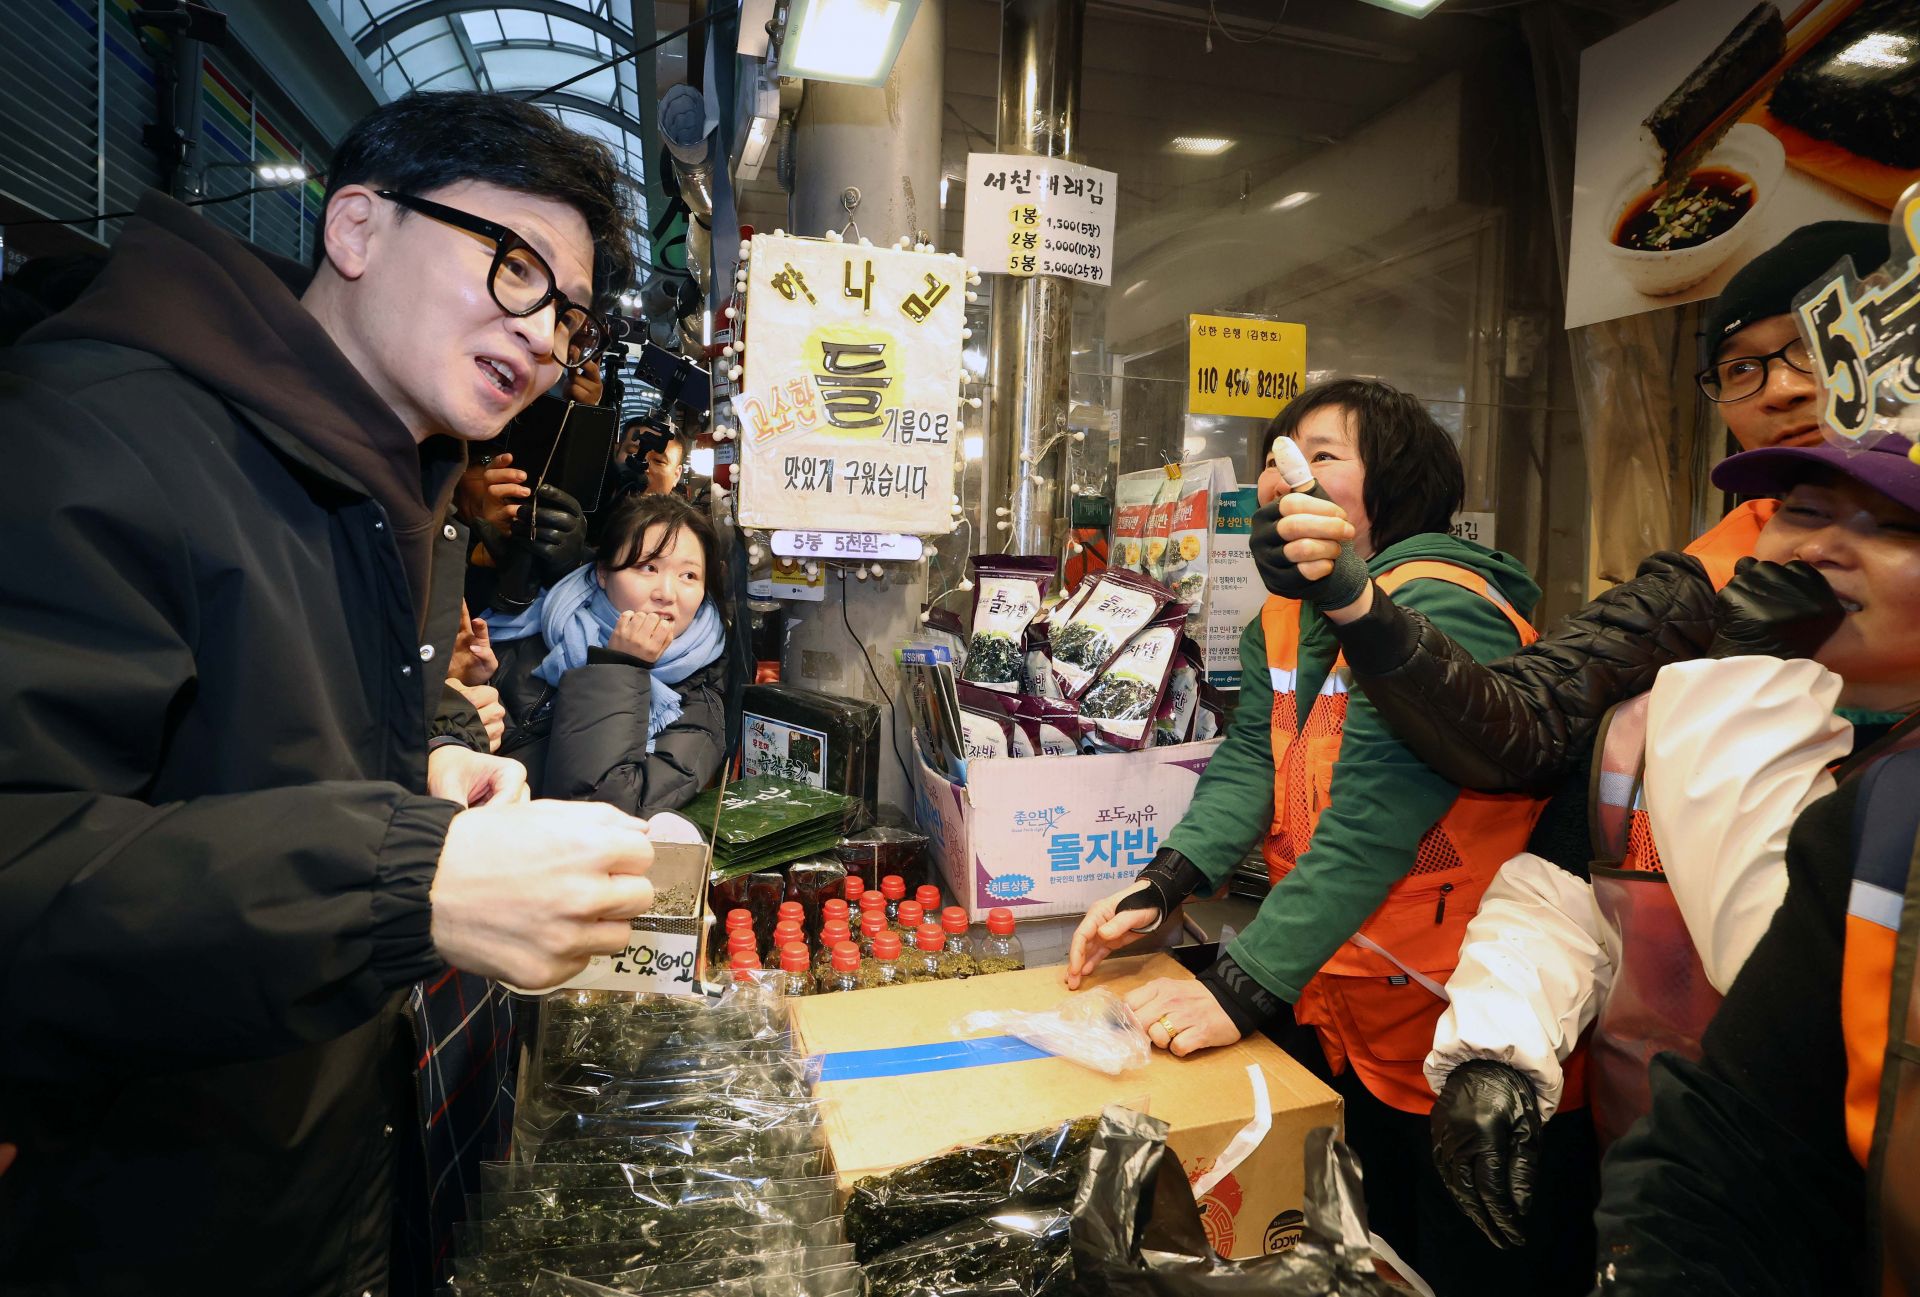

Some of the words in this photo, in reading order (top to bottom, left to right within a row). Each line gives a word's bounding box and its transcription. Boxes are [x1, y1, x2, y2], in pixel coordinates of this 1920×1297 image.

[1011, 232, 1037, 250] 2봉
[1010, 255, 1036, 272] 5봉
[1198, 325, 1217, 337] 신한
[1222, 327, 1241, 339] 은행
[1198, 367, 1218, 394] 110
[1225, 368, 1250, 397] 496
[1256, 369, 1298, 400] 821316
[743, 374, 820, 445] 고소한
[882, 408, 949, 445] 기름으로
[784, 456, 833, 494] 맛있게
[843, 461, 928, 499] 구웠습니다
[1095, 804, 1158, 827] 포도씨유
[1047, 826, 1159, 872] 돌자반
